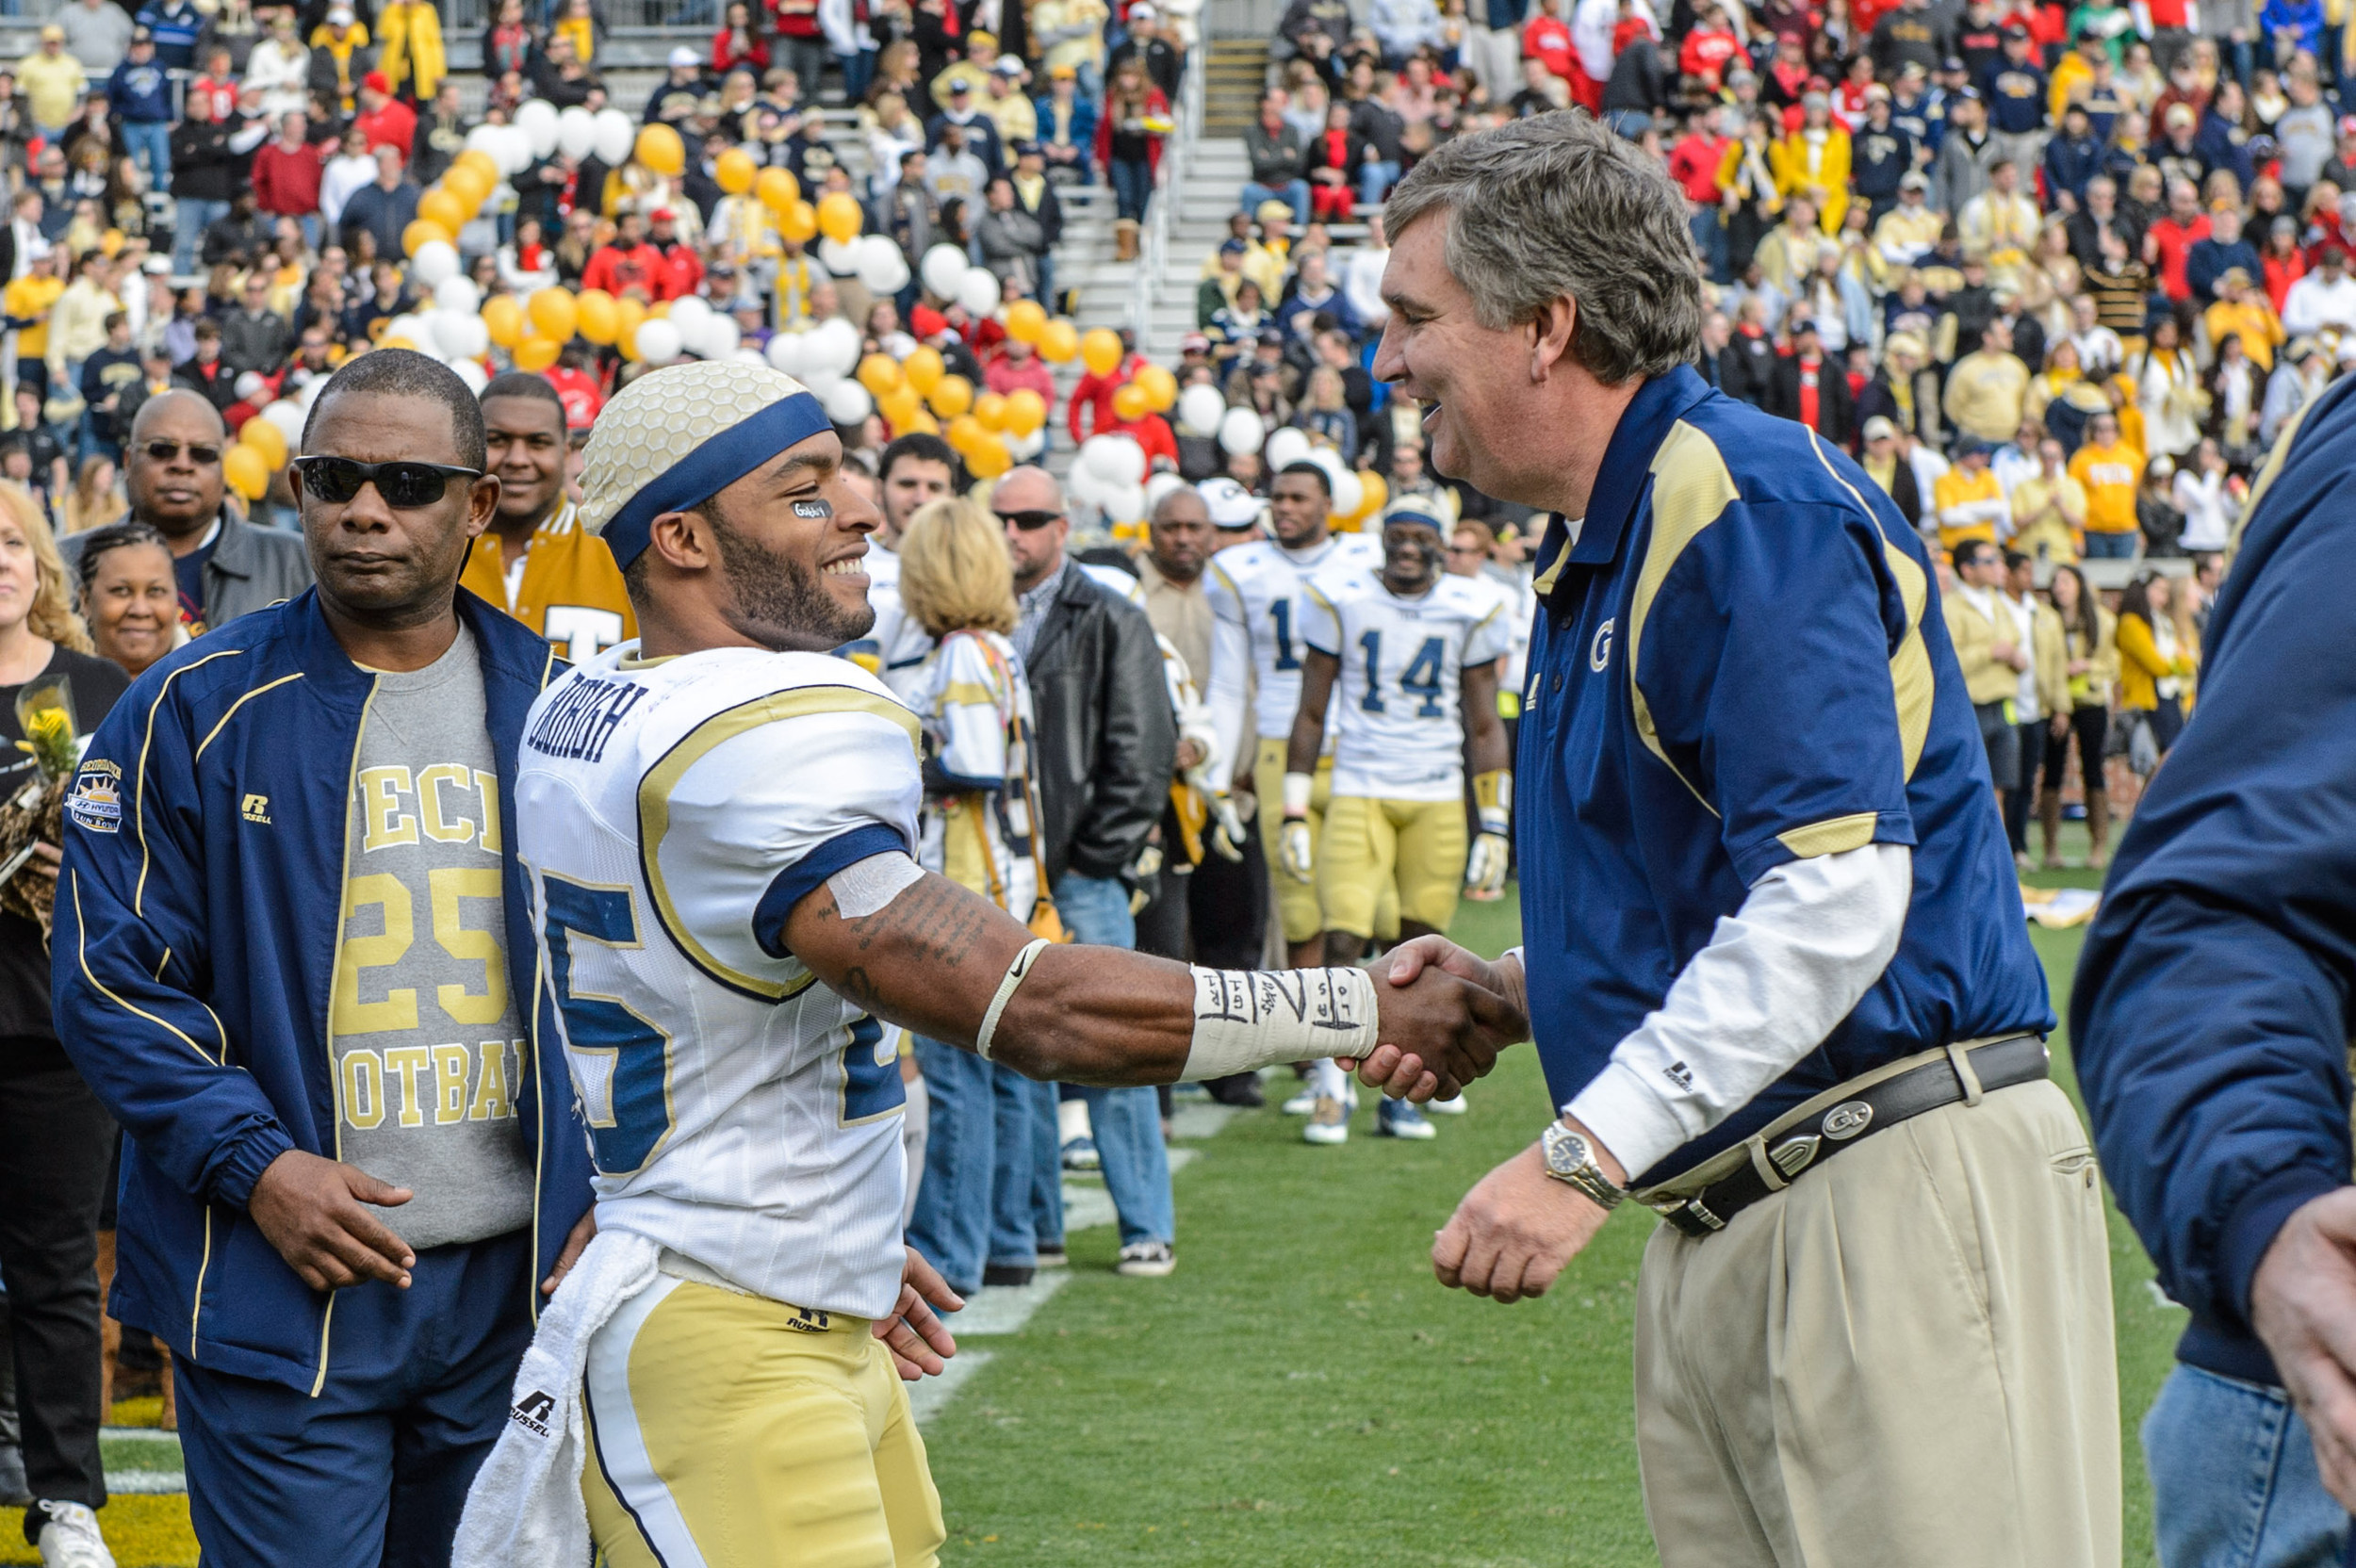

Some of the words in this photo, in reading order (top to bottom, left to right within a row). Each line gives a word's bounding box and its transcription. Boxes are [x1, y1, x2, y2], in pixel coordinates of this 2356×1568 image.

[1359, 629, 1447, 718] 14
[352, 763, 502, 855] EC
[333, 868, 509, 1036] 25
[334, 1038, 527, 1130] OTBA
